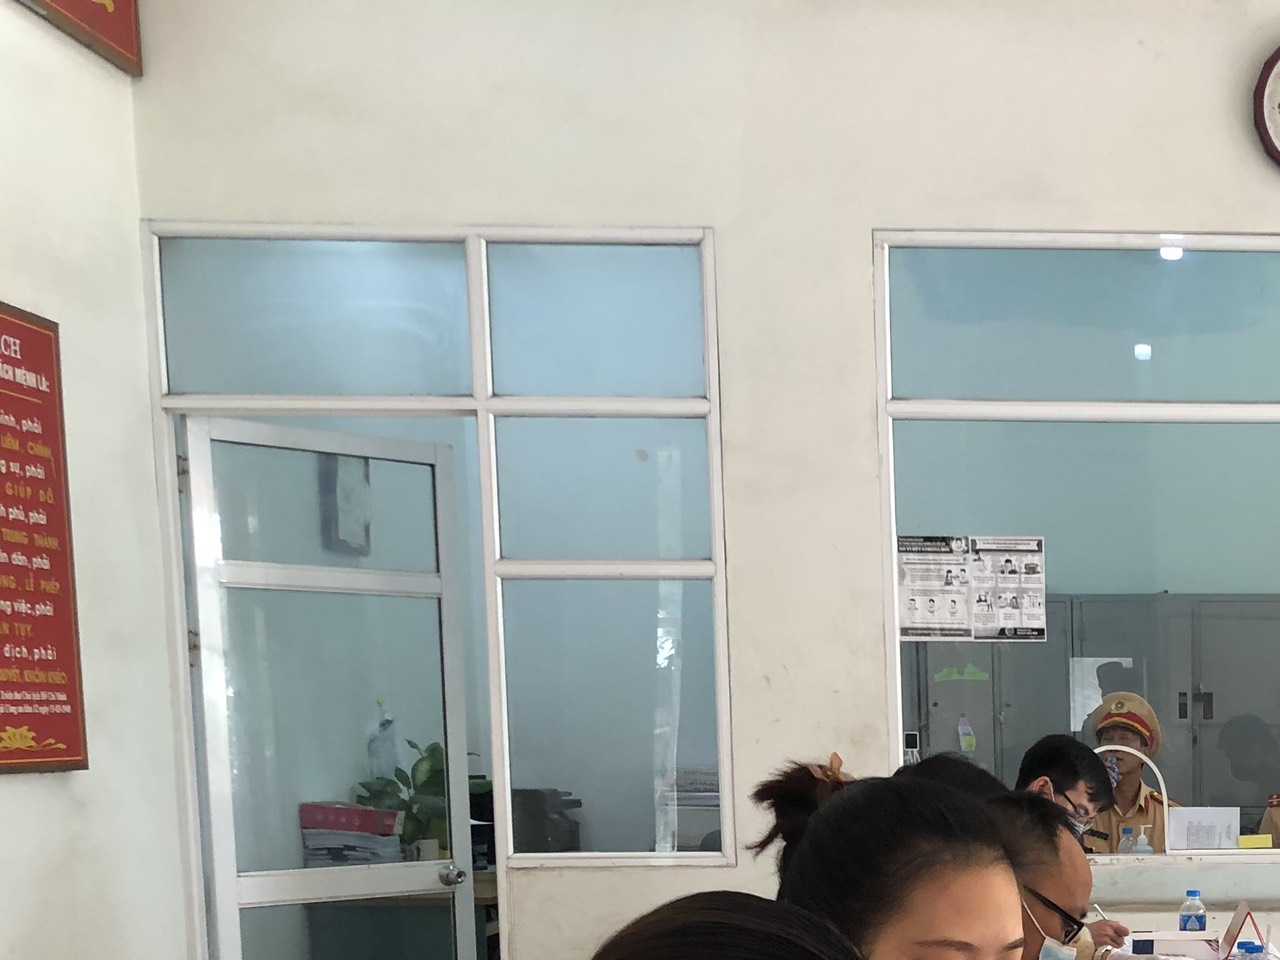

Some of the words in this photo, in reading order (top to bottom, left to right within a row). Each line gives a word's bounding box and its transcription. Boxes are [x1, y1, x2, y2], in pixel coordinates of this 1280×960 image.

[22, 416, 42, 434] phải
[25, 463, 45, 479] phải
[6, 481, 32, 499] GIÚP
[29, 508, 47, 525] phải
[32, 553, 51, 570] phải
[35, 600, 55, 617] phải
[4, 643, 32, 661] địch,
[33, 644, 57, 662] phải
